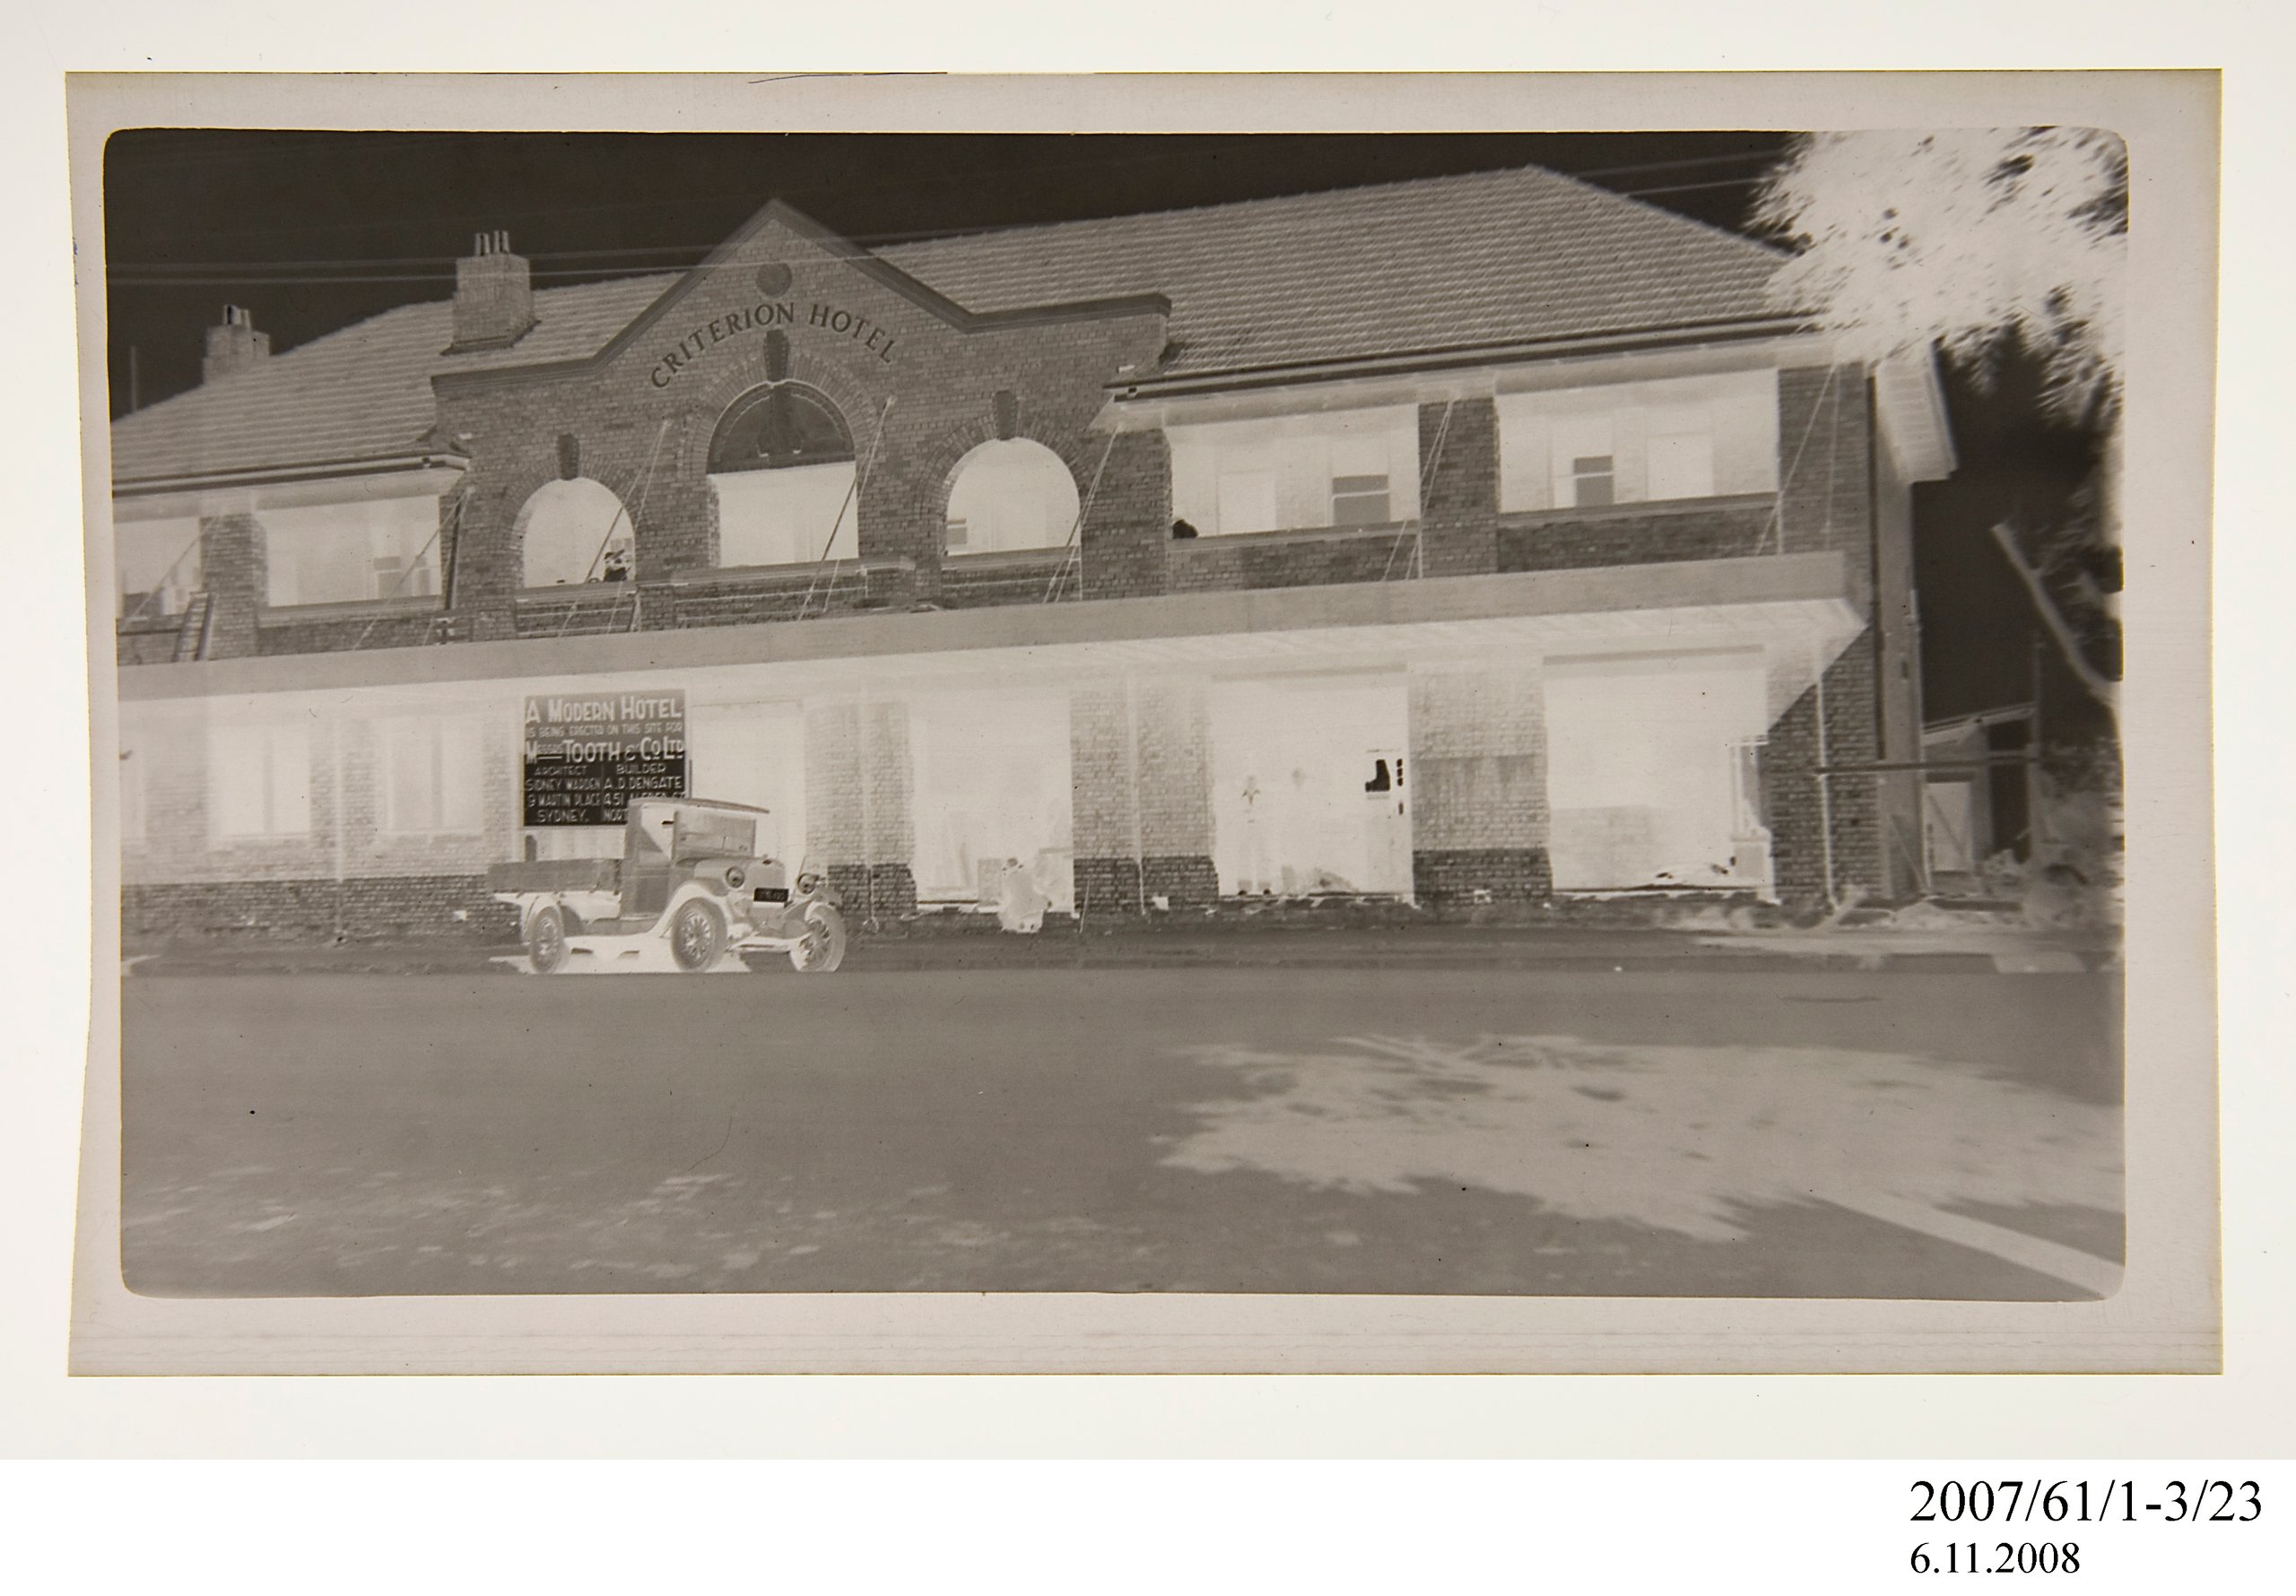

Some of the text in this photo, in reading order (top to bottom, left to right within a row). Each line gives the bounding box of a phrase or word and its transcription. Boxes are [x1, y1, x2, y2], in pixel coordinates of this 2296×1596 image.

[650, 302, 898, 388] CRITERION HOTEL
[526, 696, 683, 724] A MODERN HOTEL
[538, 726, 565, 738] BEING
[569, 724, 604, 736] ERECTED
[607, 724, 619, 735] ON
[622, 724, 640, 734] THIS
[644, 722, 662, 733] SITE
[665, 721, 683, 733] FOR
[562, 740, 621, 763] TOOTH
[623, 744, 639, 761] &
[534, 765, 587, 776] ARCHITECT
[616, 763, 666, 775] BUILDER
[525, 778, 561, 791] SIDNEY
[629, 776, 682, 789] DENGATE
[528, 793, 600, 807] 9 MARTIN PLACE
[604, 809, 629, 821] NORT
